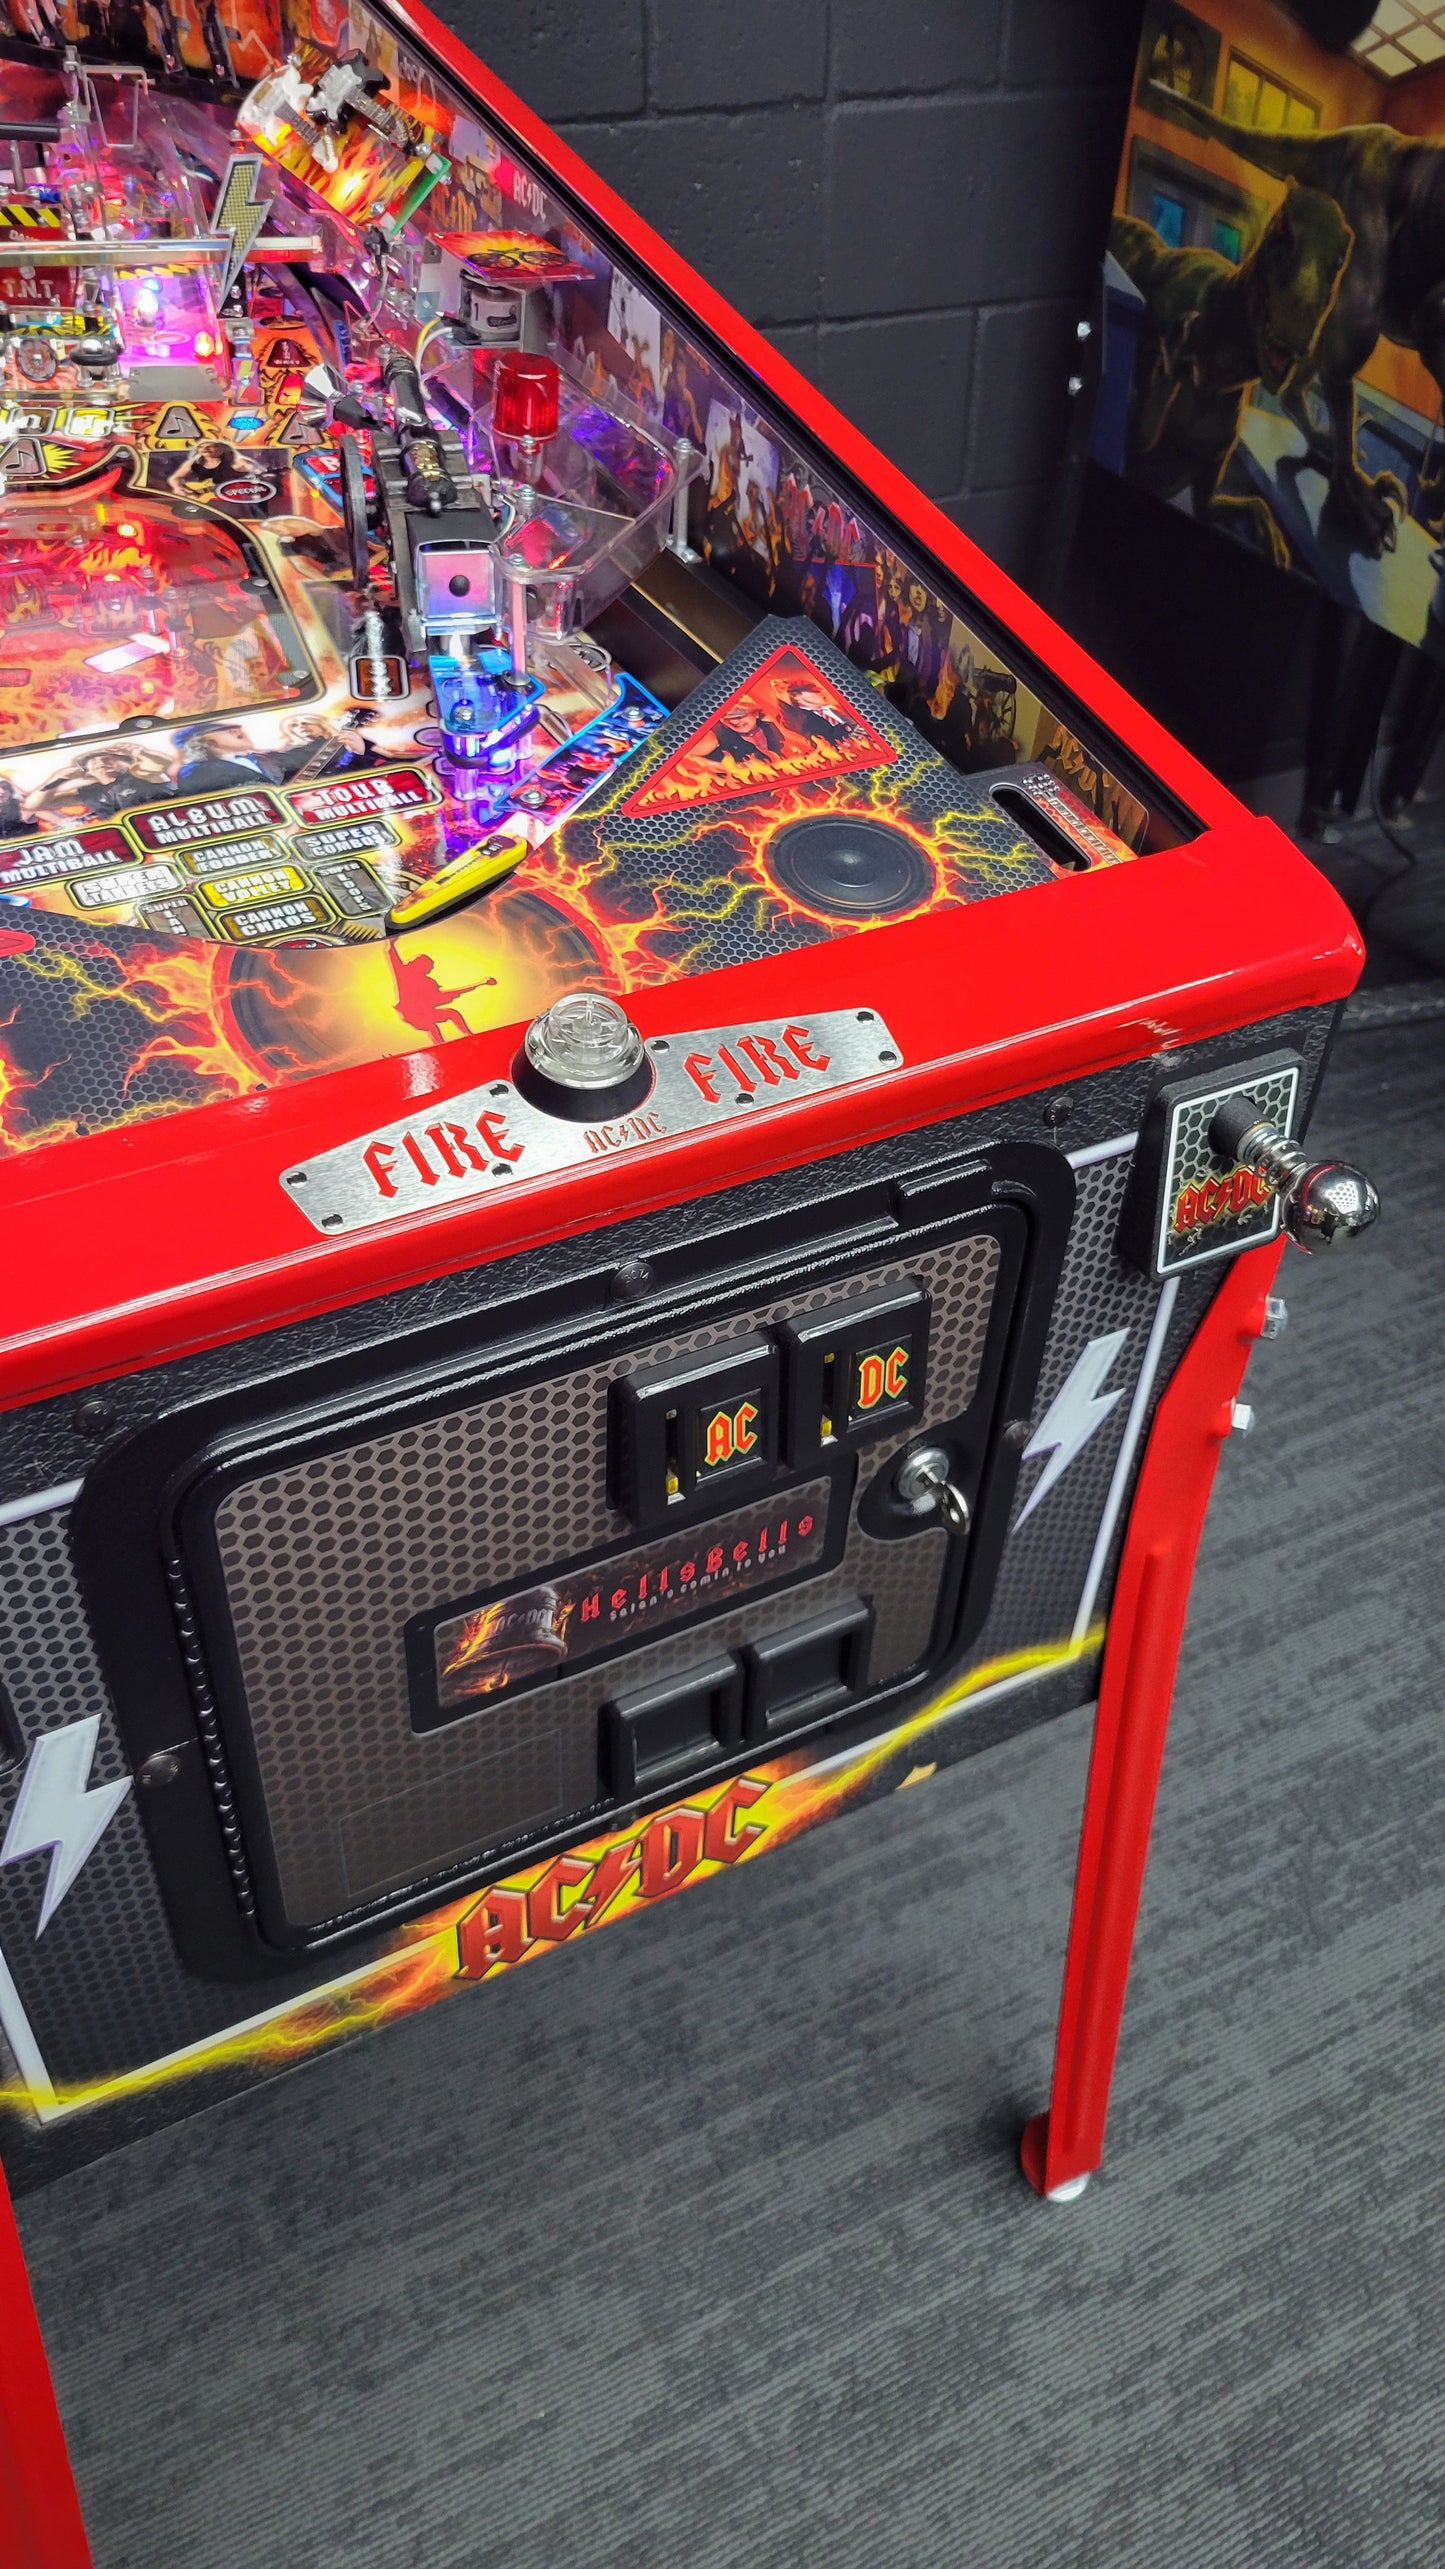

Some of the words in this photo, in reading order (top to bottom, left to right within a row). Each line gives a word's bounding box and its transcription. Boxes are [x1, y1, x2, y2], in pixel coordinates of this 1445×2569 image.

[314, 790, 423, 821] MULTIBALL
[315, 779, 395, 807] TOUR
[147, 797, 260, 832] ALBUM
[153, 812, 269, 844] MULTIBALL
[193, 838, 265, 862] CANNON
[304, 825, 380, 847] SUPER
[15, 838, 86, 866] JAM
[198, 849, 273, 873] FODDER
[0, 849, 122, 884] MULTIBALL
[318, 861, 361, 877] SUPER
[83, 869, 163, 893] SUPER
[213, 870, 290, 893] CANNON
[220, 880, 292, 904] VOLLEY
[336, 873, 372, 911] LOOPS
[142, 898, 188, 914] SUPER
[233, 901, 310, 926] CANNON
[163, 909, 188, 937] LAN
[240, 911, 317, 937] CHAOS
[682, 1023, 832, 1104] FIRE
[583, 1111, 668, 1155] AC/DC
[362, 1110, 527, 1199] FIRE
[857, 1346, 910, 1409] DC
[704, 1402, 758, 1466] AC
[680, 1566, 729, 1594] comin
[736, 1558, 752, 1571] to
[758, 1544, 786, 1563] you
[456, 1774, 774, 1981] AC/DC
